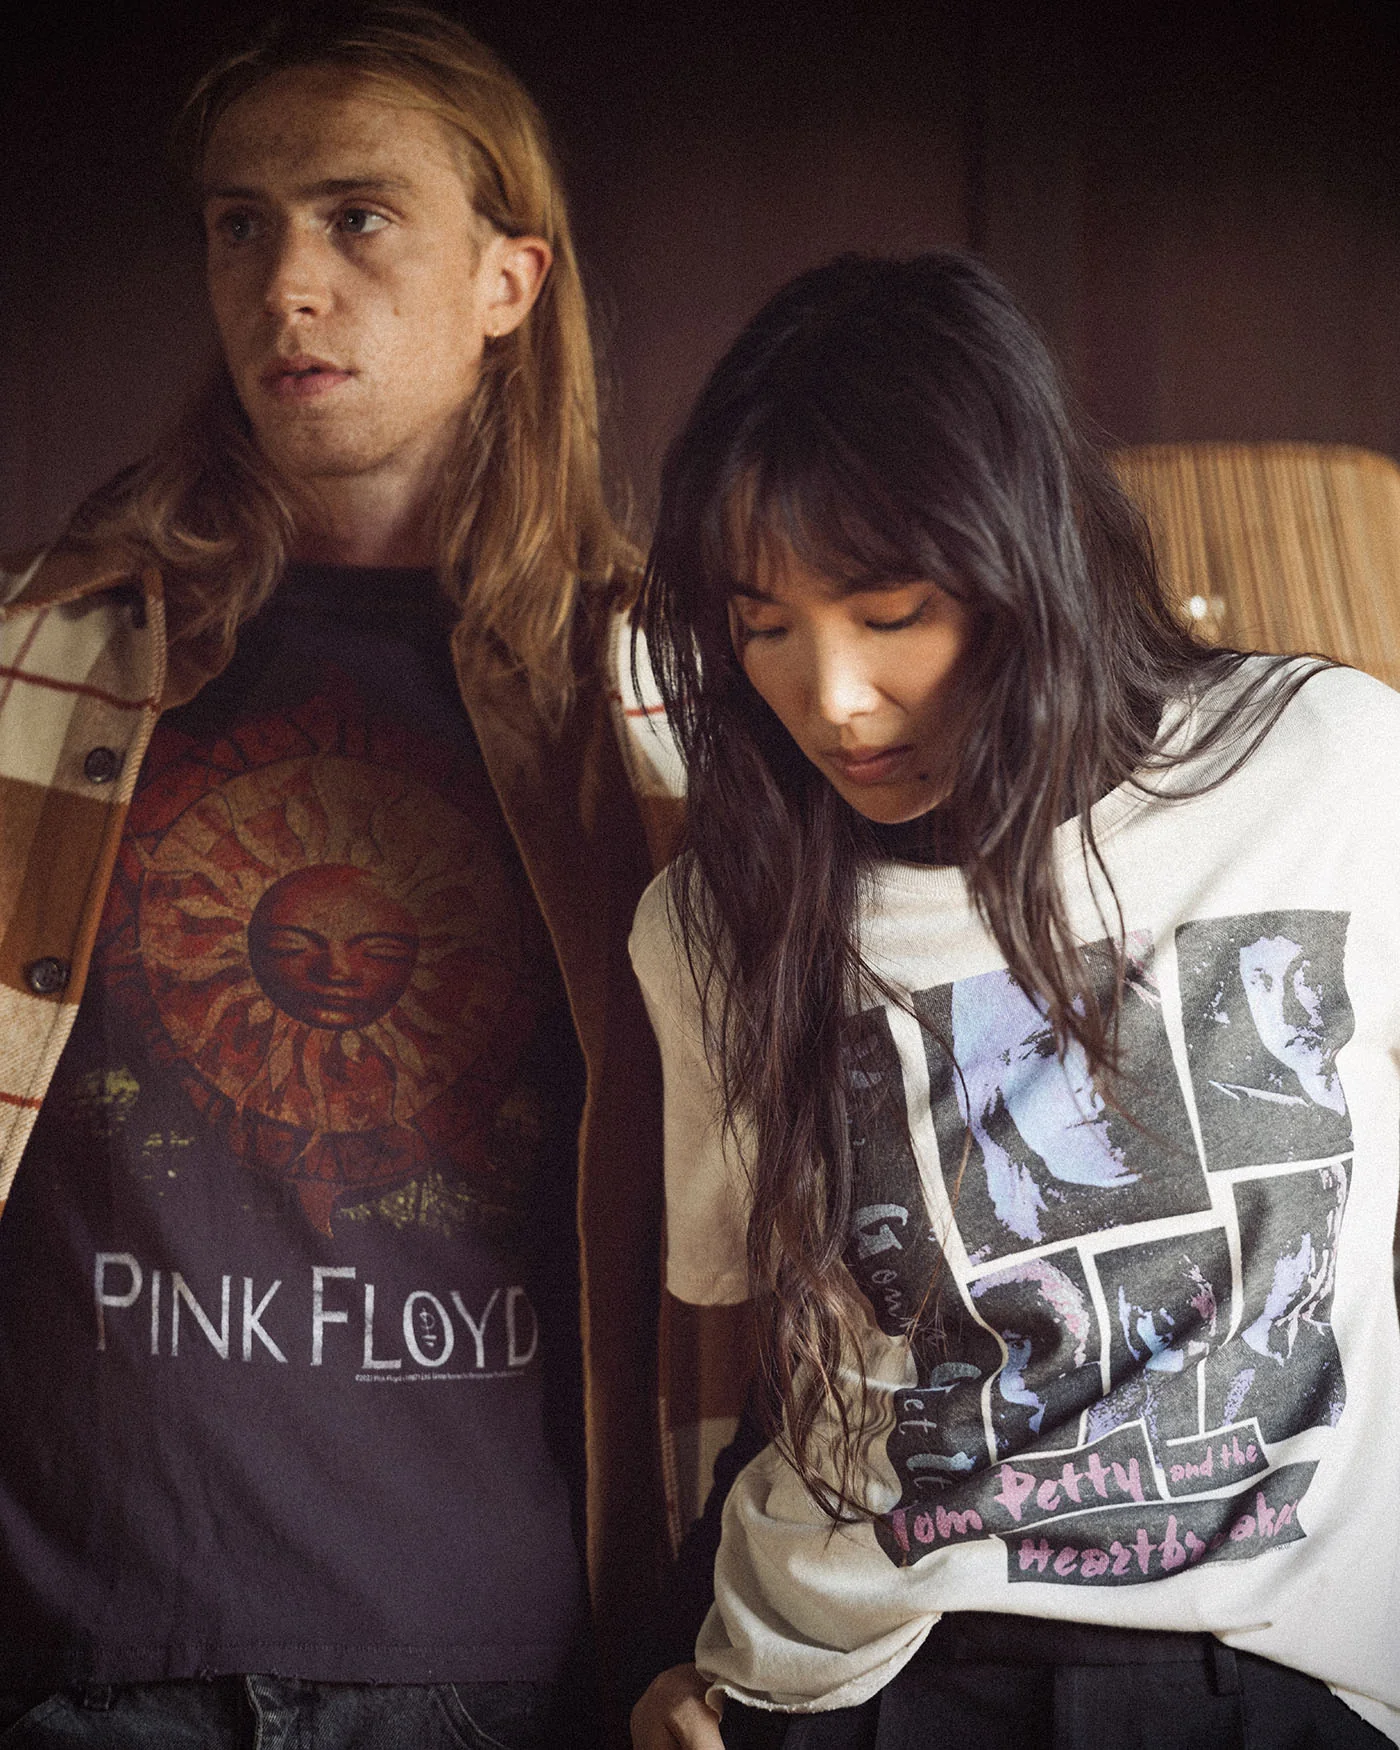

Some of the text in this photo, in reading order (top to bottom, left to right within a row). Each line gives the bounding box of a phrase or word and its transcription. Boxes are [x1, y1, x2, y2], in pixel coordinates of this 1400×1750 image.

[94, 1252, 538, 1369] PINK FLOYD
[994, 1452, 1145, 1521] Petty
[1169, 1435, 1258, 1483] and the
